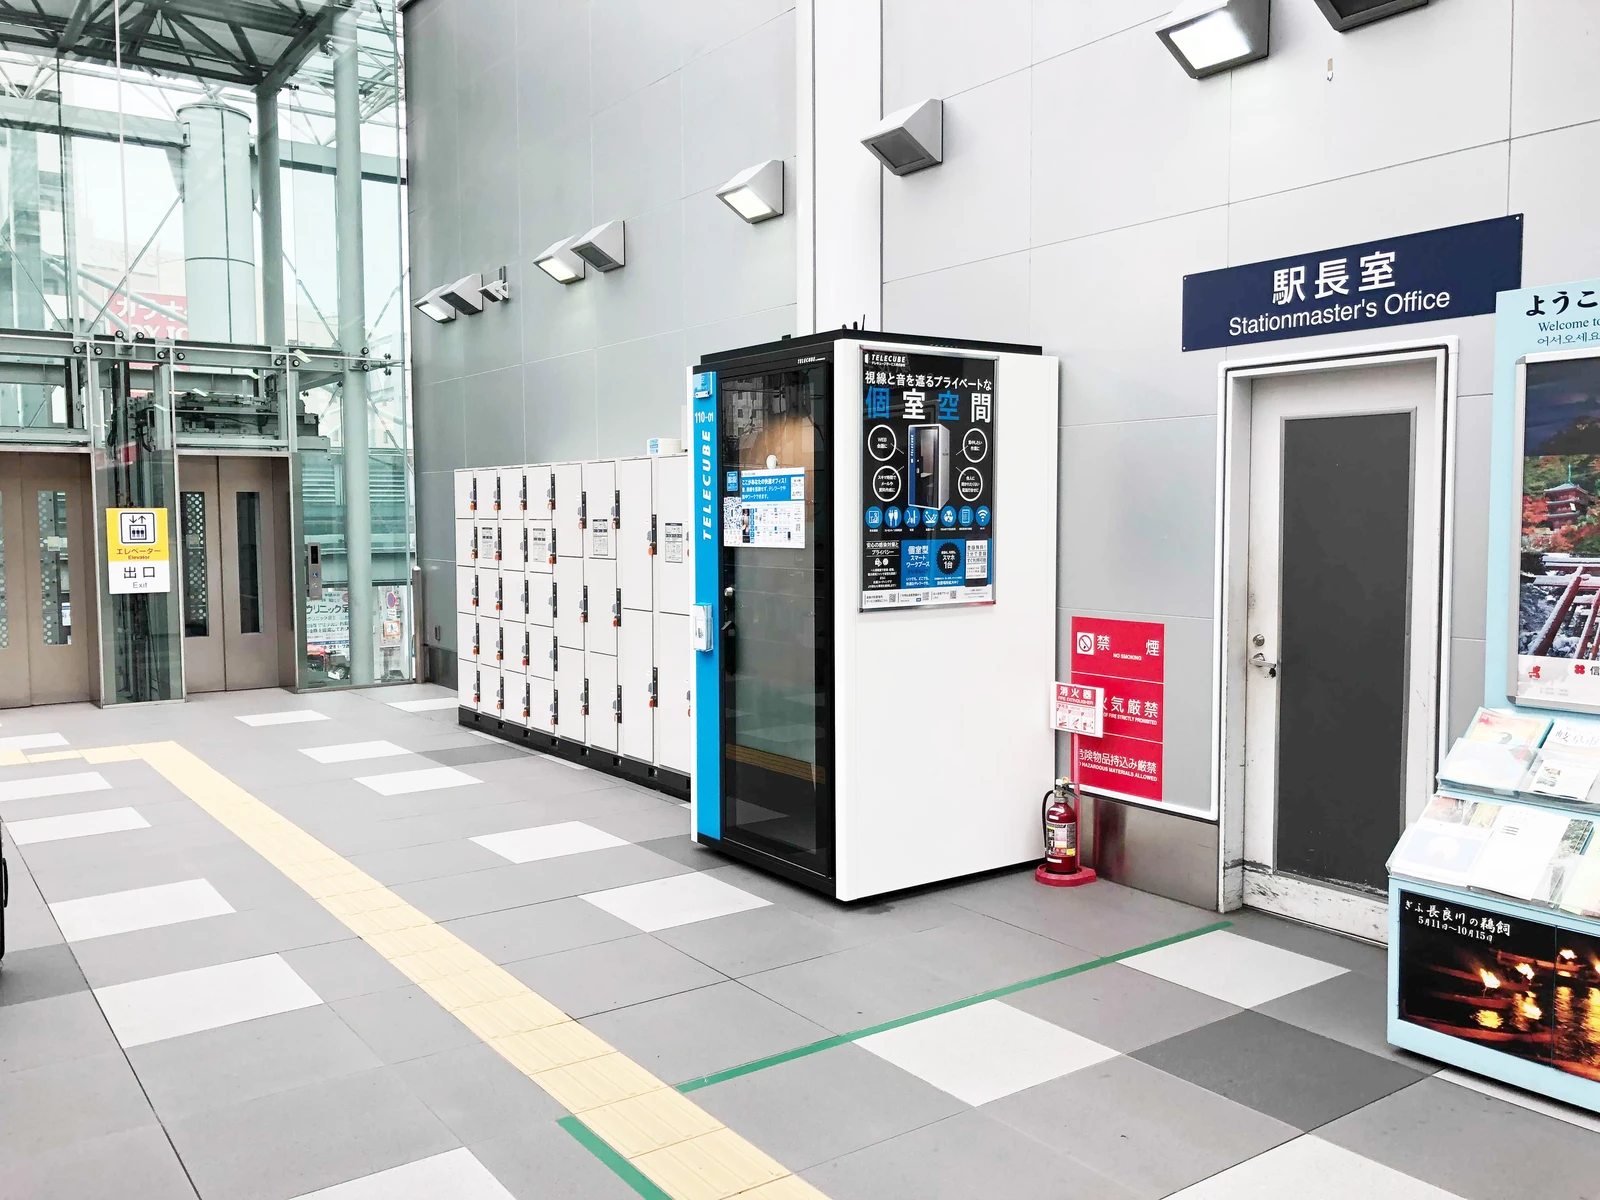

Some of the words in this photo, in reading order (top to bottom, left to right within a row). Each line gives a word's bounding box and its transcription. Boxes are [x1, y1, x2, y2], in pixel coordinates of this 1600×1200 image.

[1271, 250, 1396, 306] 駅長室
[1228, 297, 1377, 338] Stationmaster's
[1384, 288, 1450, 316] Office
[1526, 291, 1598, 316] ようこ
[1538, 320, 1589, 332] Welcome
[872, 354, 906, 363] TELECUBE
[865, 371, 992, 391] 視線と音を遮るプライベートな
[865, 385, 991, 423] 個室空間
[702, 430, 713, 541] TELECUBE
[123, 566, 155, 579] 出口
[1060, 686, 1092, 700] 消火器
[1117, 714, 1134, 722] STRICTLY
[1135, 717, 1157, 725] PROHIBITED
[1082, 762, 1108, 772] HAZARDOUS
[1109, 767, 1134, 777] MATERIALS
[1135, 773, 1157, 782] ALLOWED
